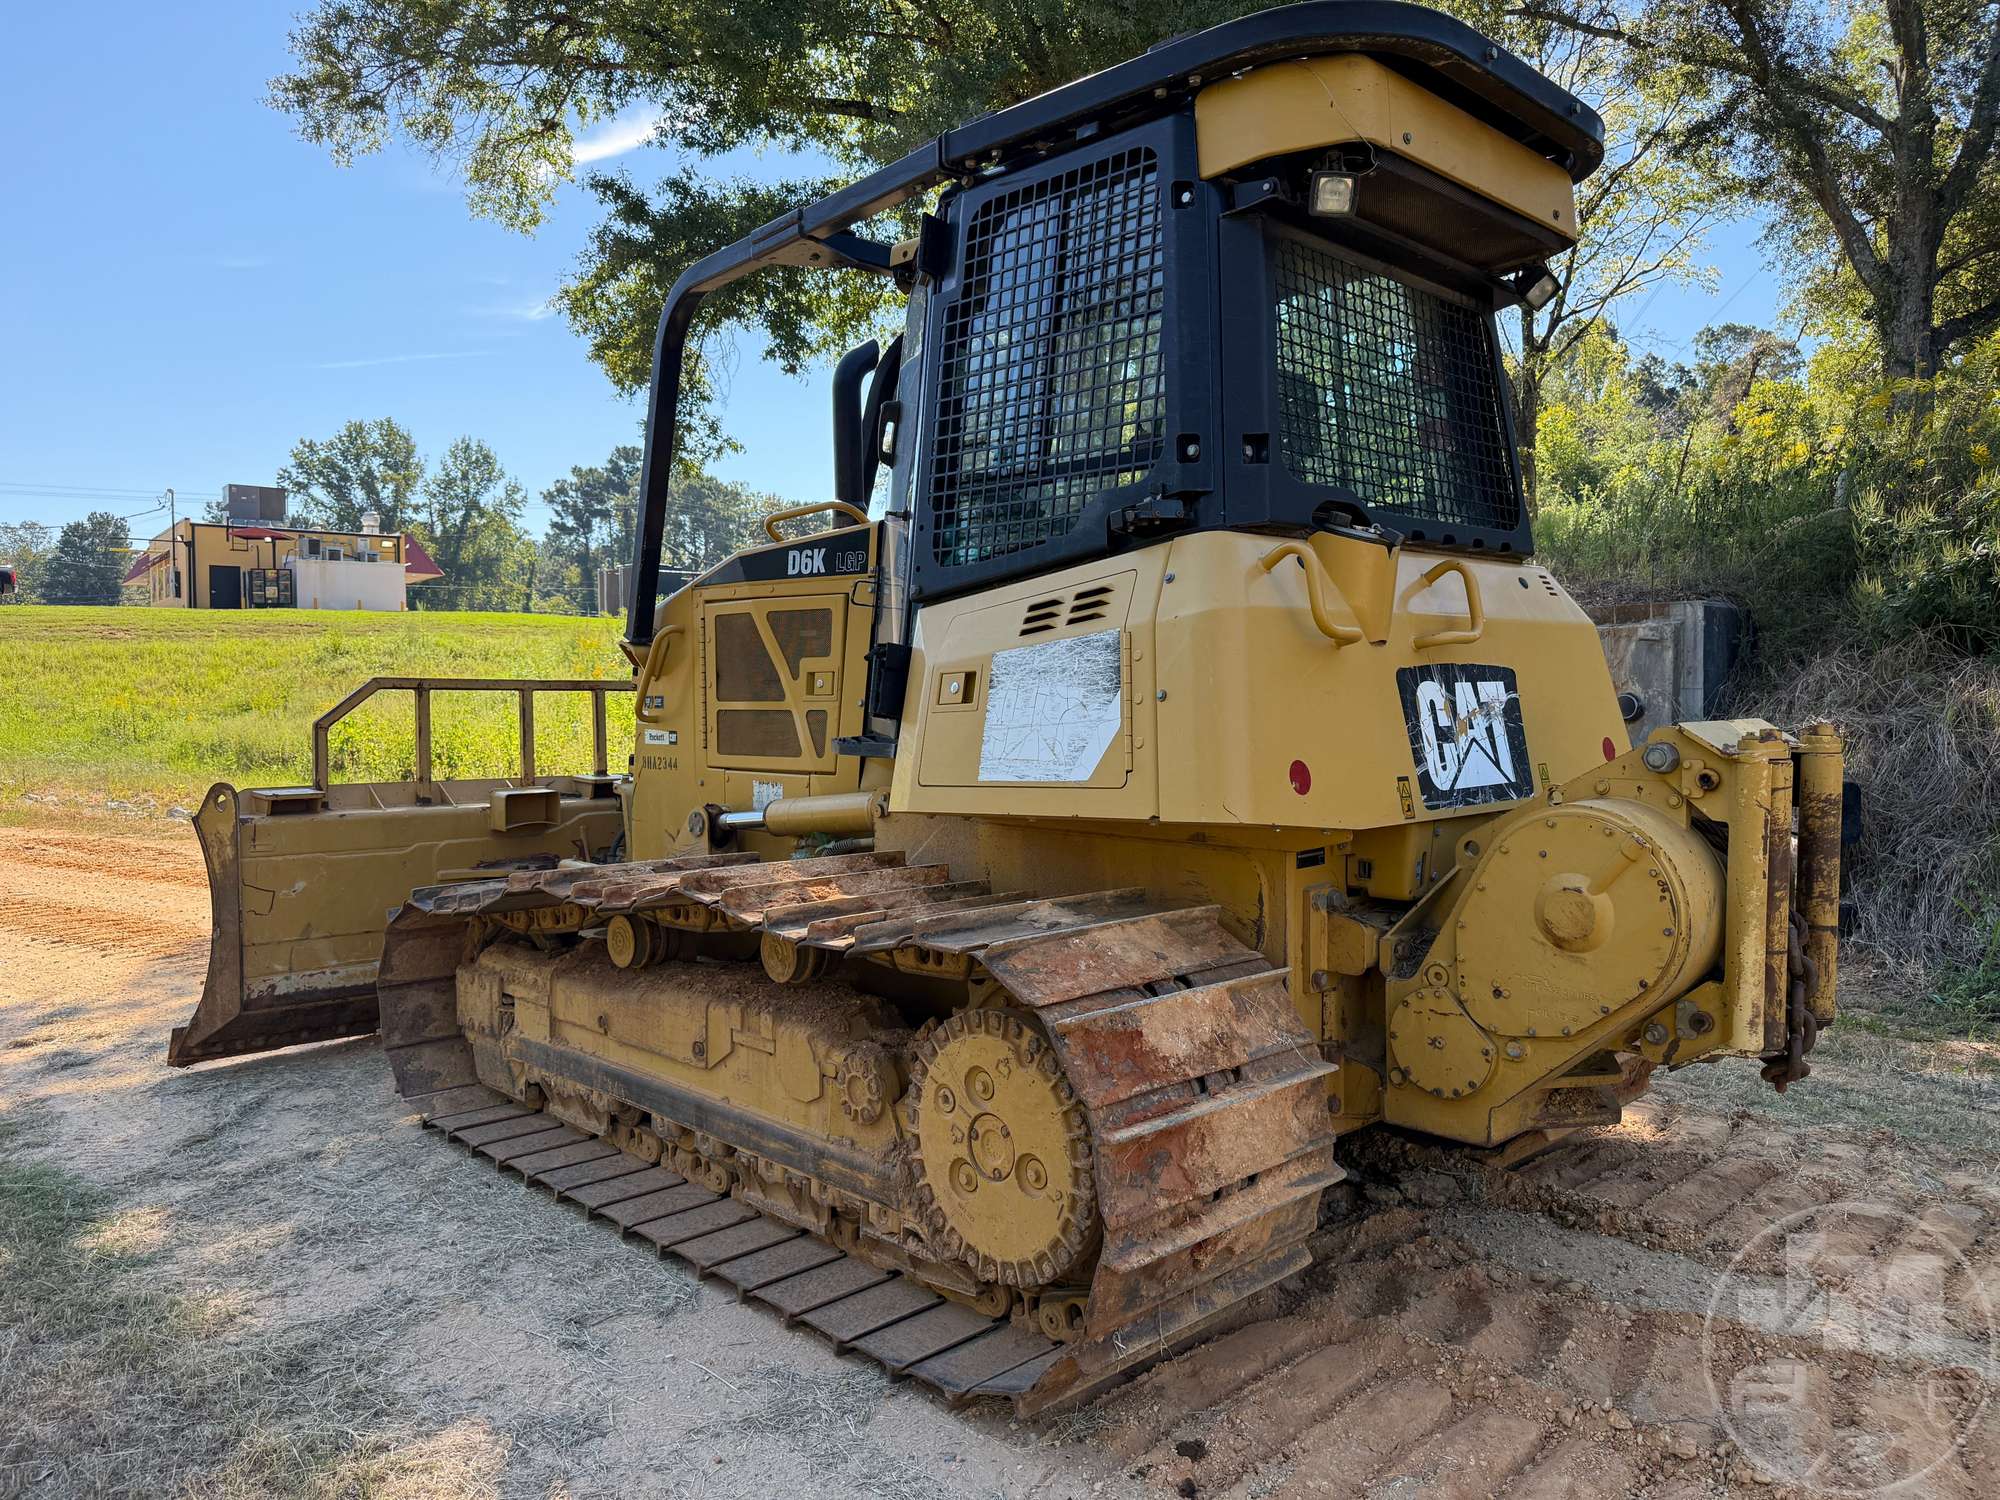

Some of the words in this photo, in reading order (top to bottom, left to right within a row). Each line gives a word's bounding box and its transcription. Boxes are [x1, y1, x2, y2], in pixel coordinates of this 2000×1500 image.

[787, 548, 826, 575] D6K
[835, 551, 866, 573] LGP
[1415, 680, 1516, 791] CAT
